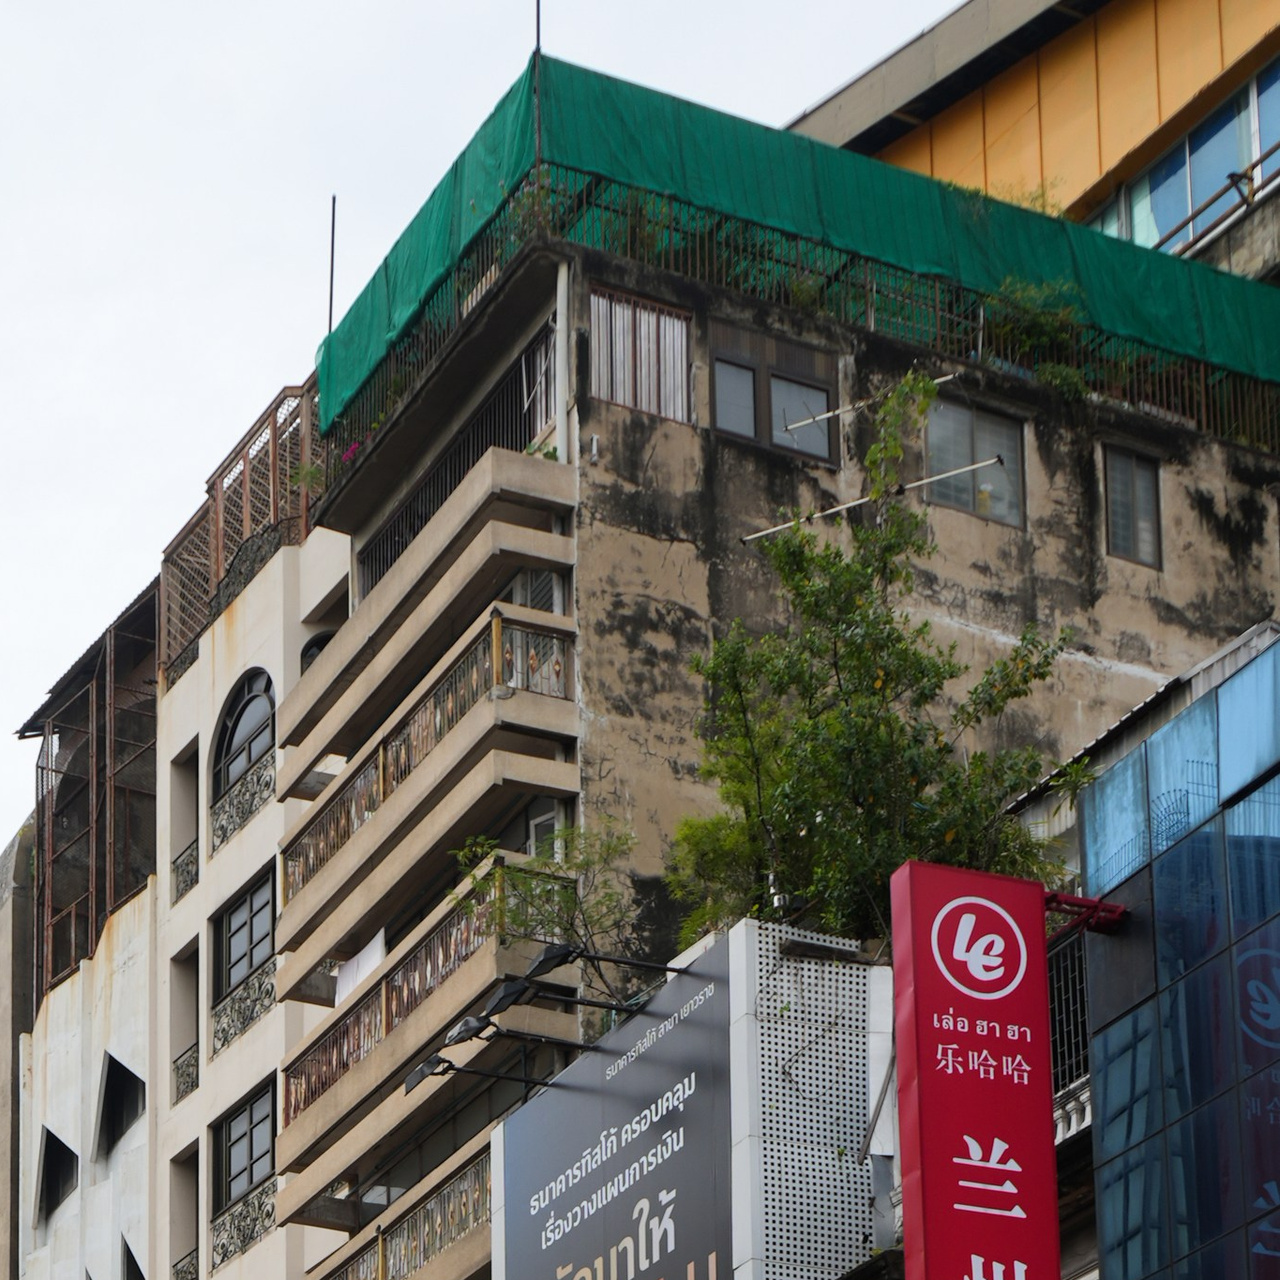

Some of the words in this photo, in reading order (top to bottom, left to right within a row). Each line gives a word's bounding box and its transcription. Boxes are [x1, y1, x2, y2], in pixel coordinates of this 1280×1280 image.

[605, 1028, 657, 1081] ธนาคารทิสโก้
[657, 1015, 678, 1041] สาขา
[680, 981, 715, 1020] เยาวราช
[933, 1007, 969, 1032] เล่อ
[976, 1018, 1001, 1037] ฮา
[1007, 1024, 1032, 1043] ฮา
[935, 1043, 1033, 1085] 乐哈哈
[529, 1128, 618, 1216] ธนาคารทิสโก้
[621, 1071, 697, 1147] ครอบคลุม
[541, 1126, 685, 1250] เรื่องวางแผนการเงิน
